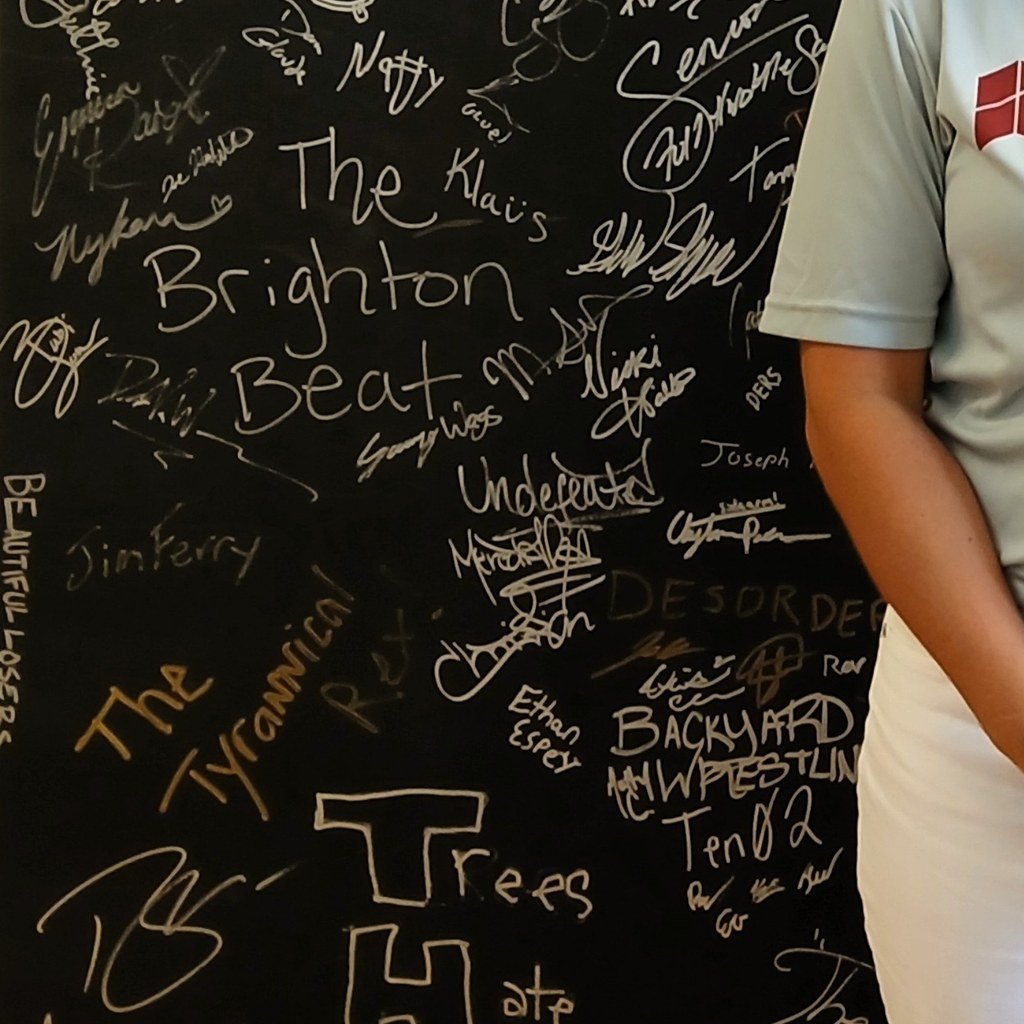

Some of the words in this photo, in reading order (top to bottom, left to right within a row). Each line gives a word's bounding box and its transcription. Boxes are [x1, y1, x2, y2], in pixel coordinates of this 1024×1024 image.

[278, 126, 438, 230] The
[143, 237, 524, 360] Brighton
[230, 340, 464, 435] Beat
[700, 439, 791, 470] Joseph
[1, 472, 46, 627] BEAUTIFUL
[74, 663, 215, 760] The
